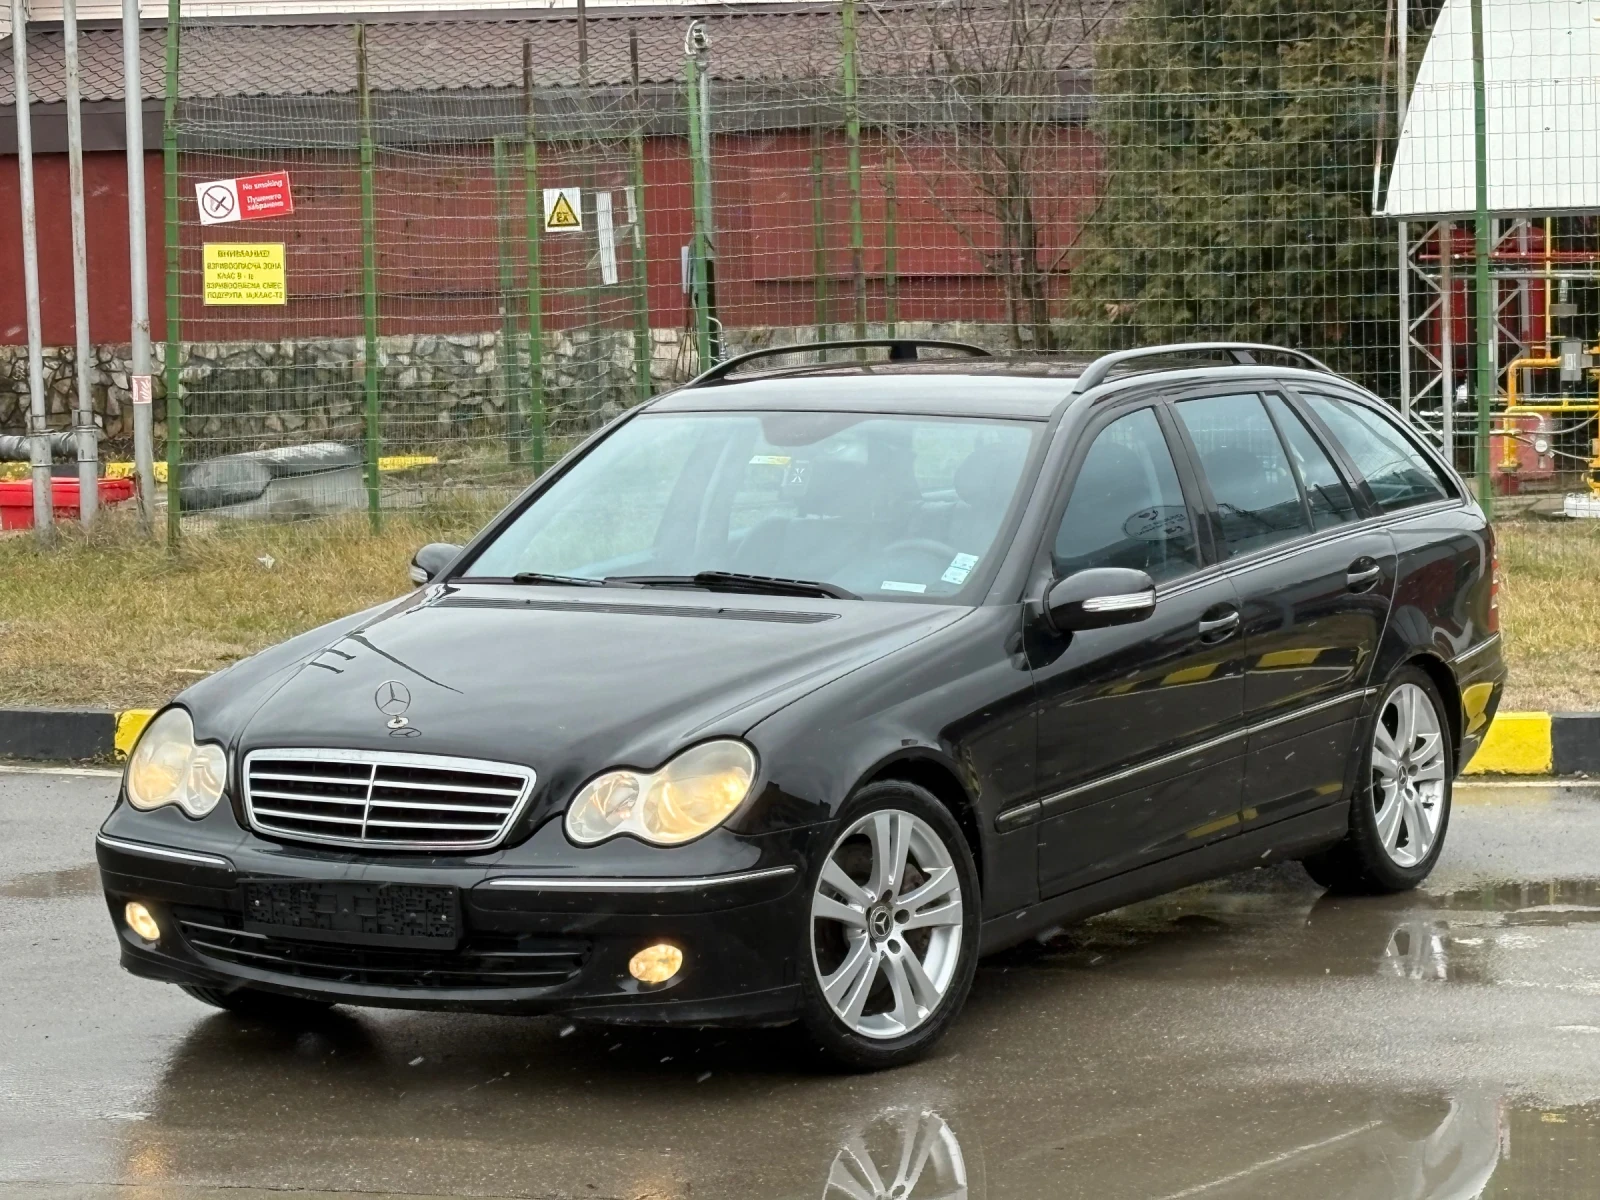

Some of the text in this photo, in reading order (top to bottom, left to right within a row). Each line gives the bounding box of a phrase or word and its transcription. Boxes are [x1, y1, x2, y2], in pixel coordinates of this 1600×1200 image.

[242, 180, 283, 191] No smoking
[263, 262, 282, 270] ЗОНА
[217, 272, 235, 280] КЛАС
